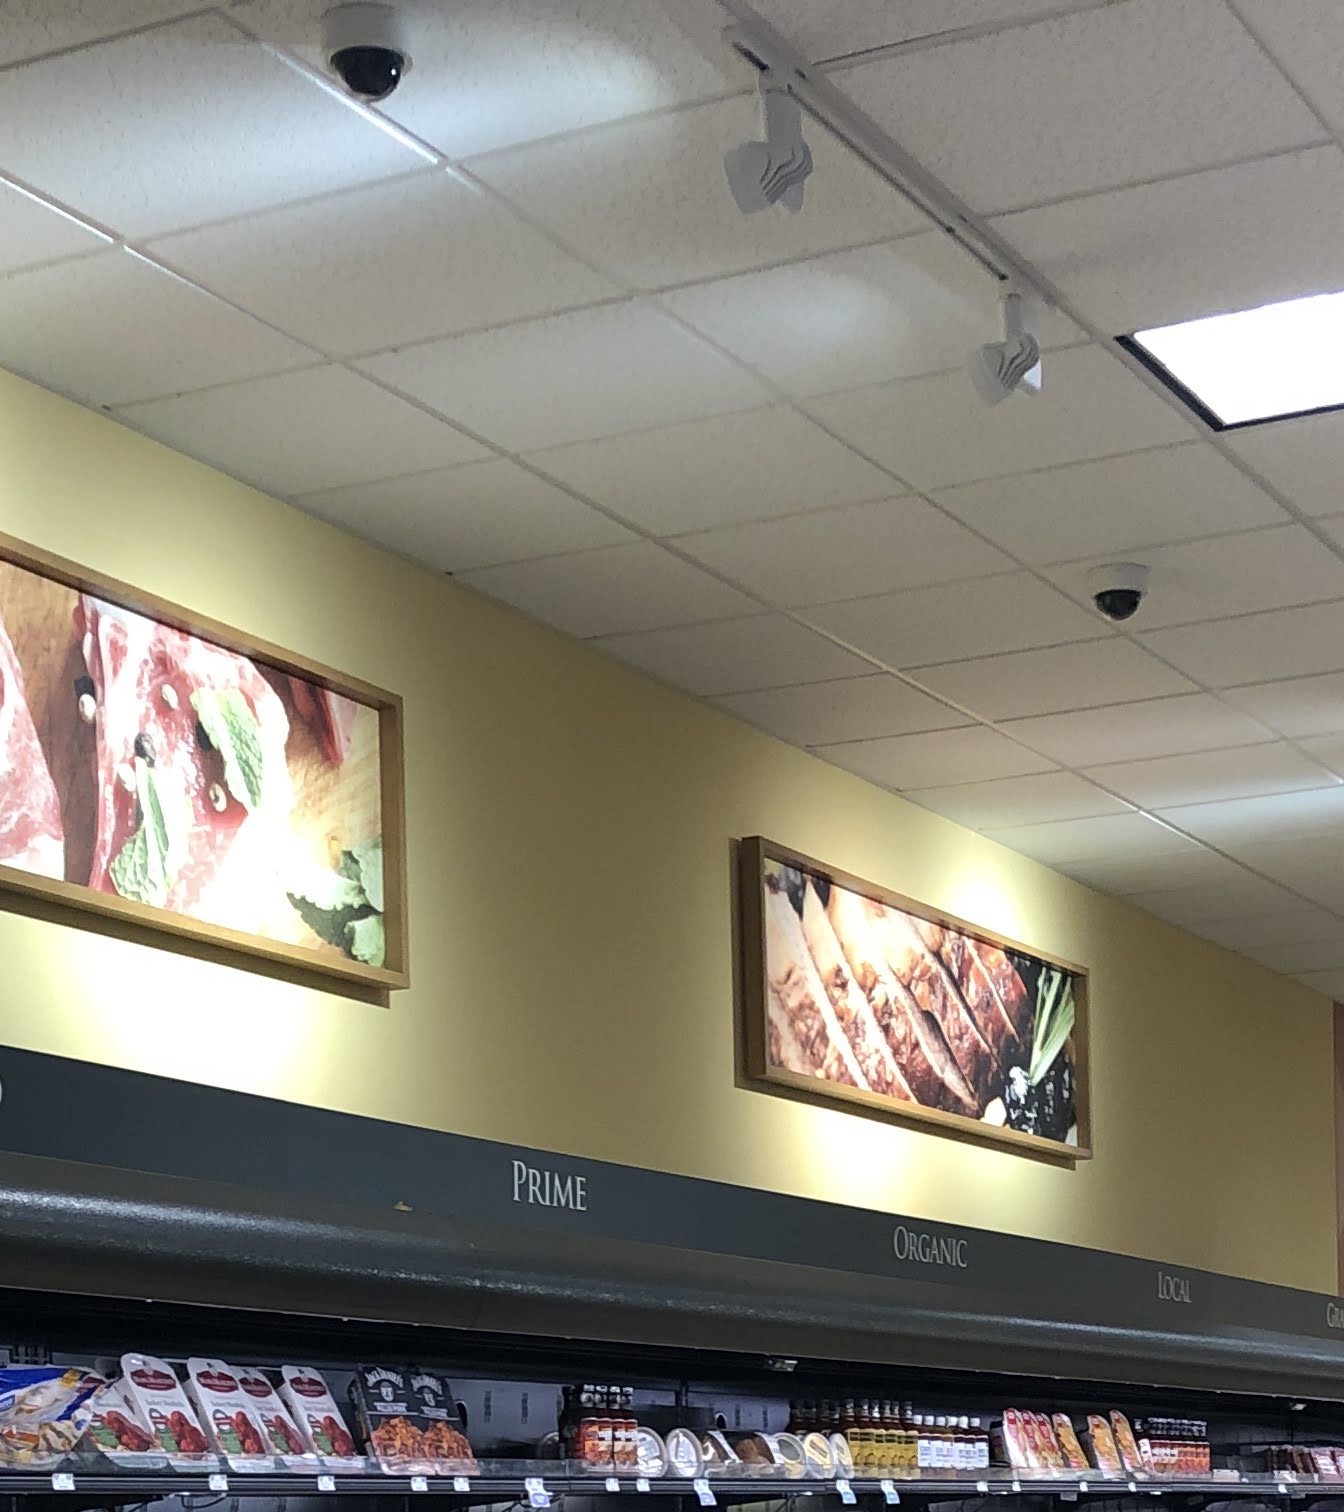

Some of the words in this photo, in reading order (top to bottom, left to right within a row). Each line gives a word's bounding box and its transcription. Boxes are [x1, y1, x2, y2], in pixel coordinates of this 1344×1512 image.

[512, 1160, 587, 1211] PRIME
[893, 1226, 968, 1268] ORGANIC
[1158, 1271, 1192, 1303] LOCAL
